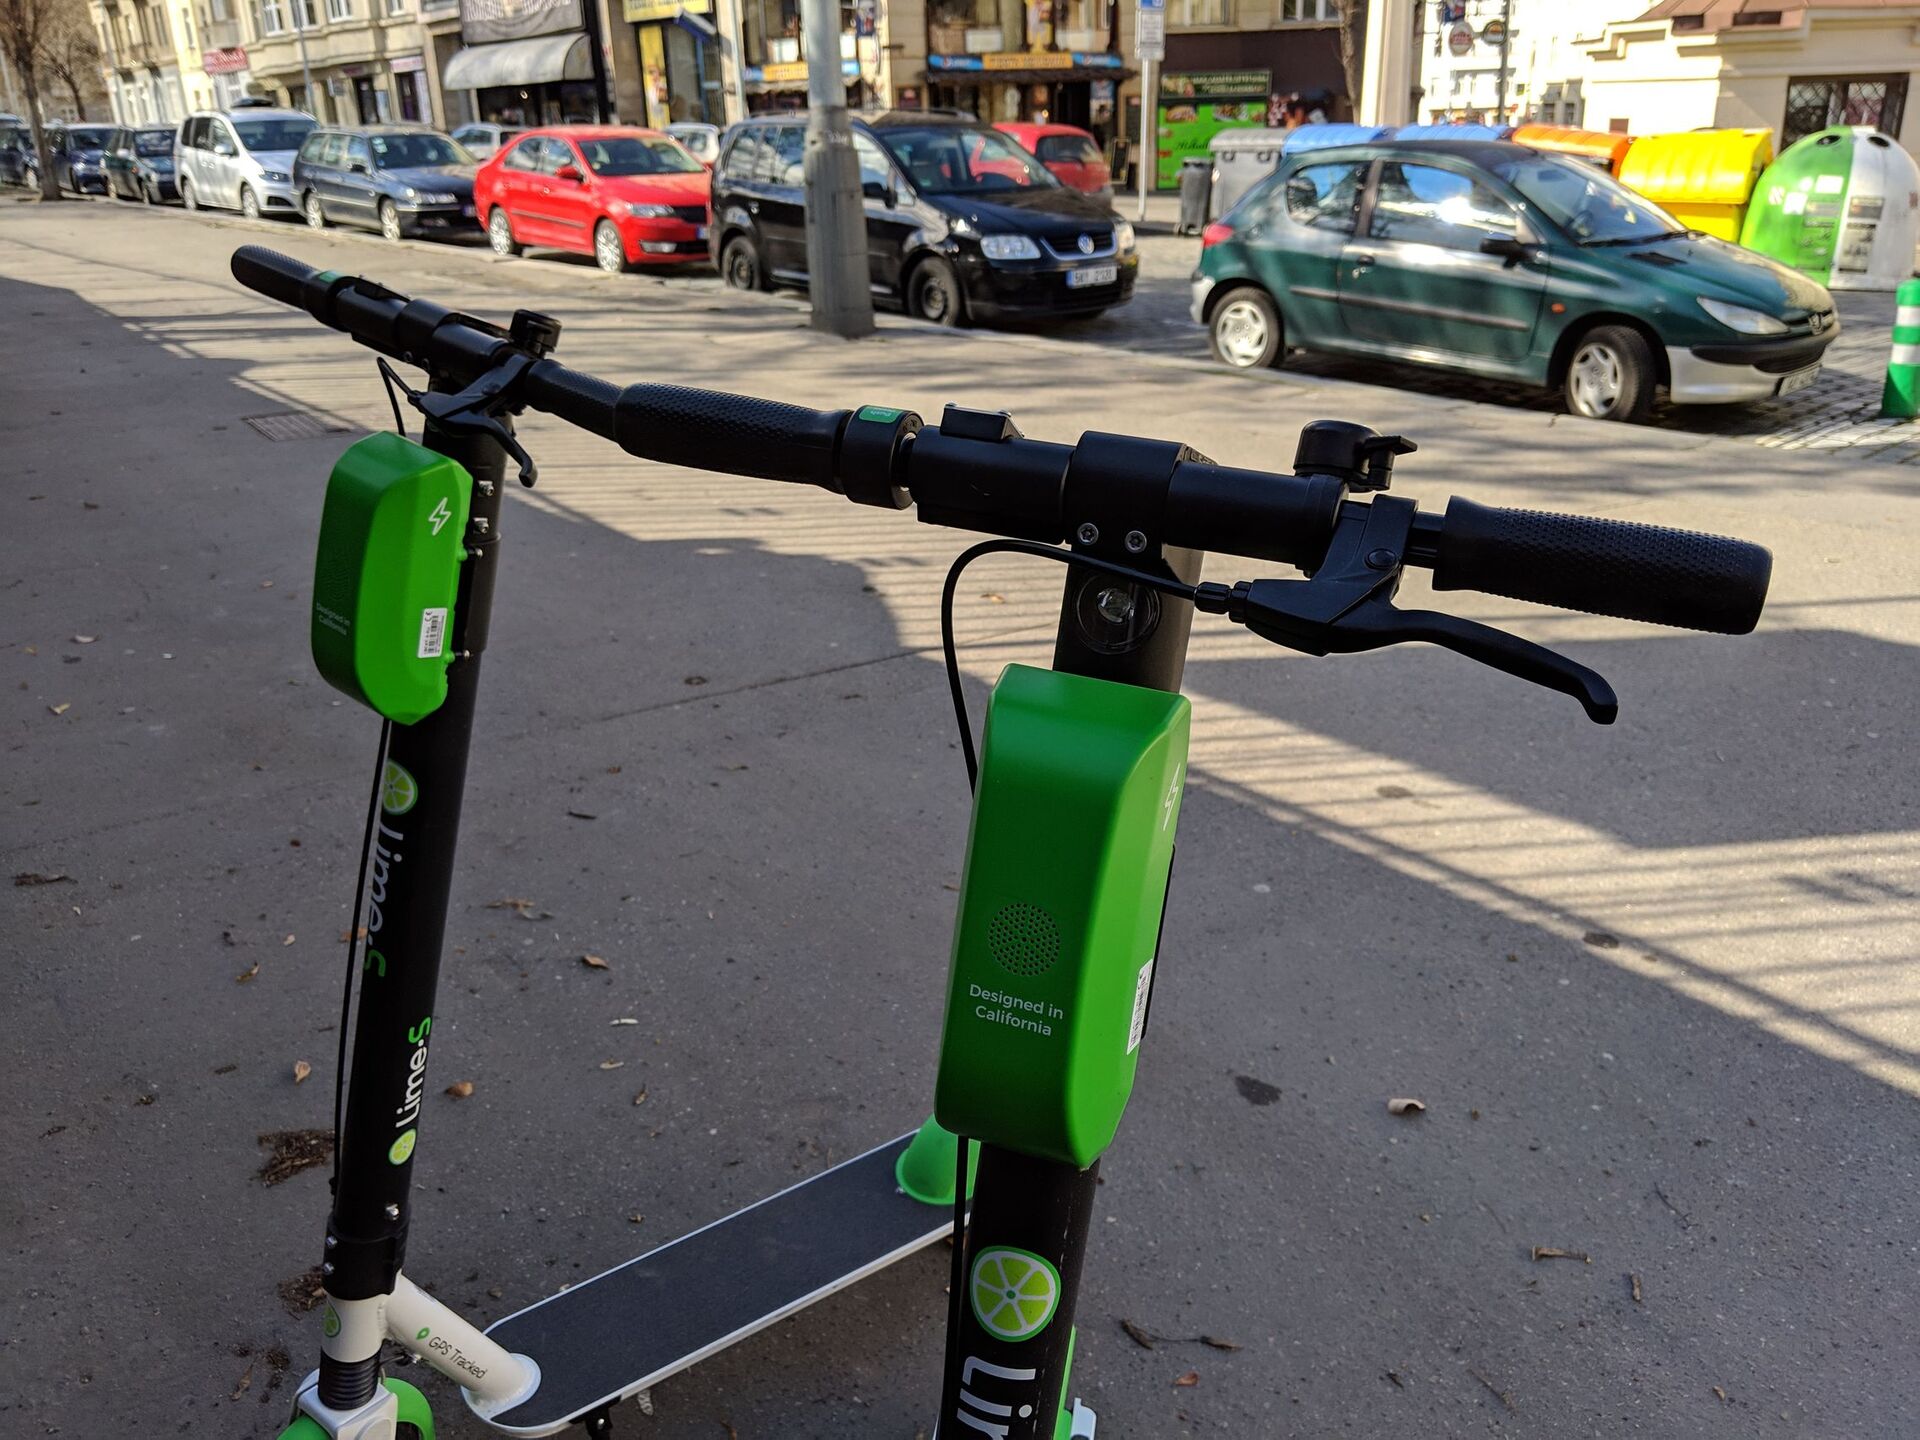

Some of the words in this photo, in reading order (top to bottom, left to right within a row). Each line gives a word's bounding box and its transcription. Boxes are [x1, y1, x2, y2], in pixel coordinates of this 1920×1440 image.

[969, 983, 1044, 1015] Designed
[1048, 1003, 1064, 1020] in
[975, 1005, 1052, 1036] California
[429, 1336, 453, 1356] GPS
[449, 1348, 489, 1379] Tracked
[956, 1355, 1036, 1440] Li
